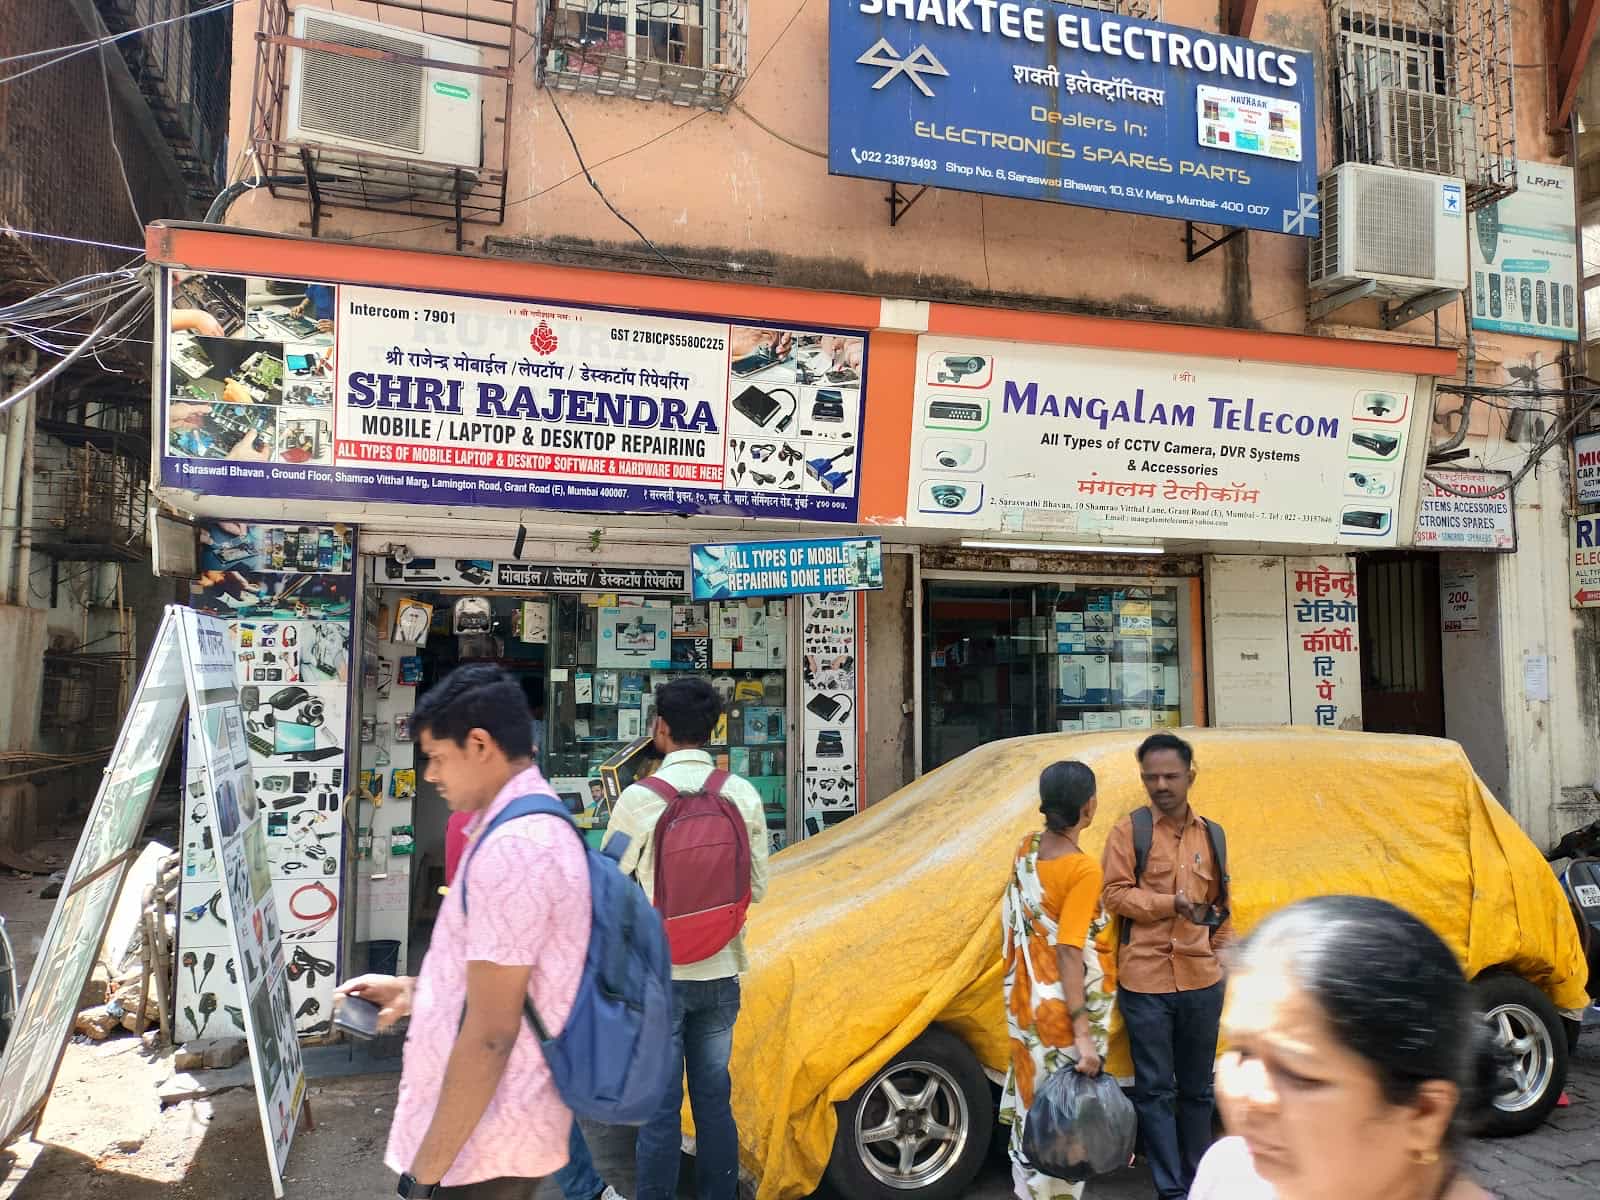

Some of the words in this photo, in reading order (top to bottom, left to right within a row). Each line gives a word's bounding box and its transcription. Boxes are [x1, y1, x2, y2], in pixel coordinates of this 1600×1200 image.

[1057, 13, 1297, 87] ELECTRONICS
[1012, 64, 1060, 87] शक्ती
[1065, 70, 1166, 106] इलेक्ट्रॉनिक्स
[1031, 105, 1117, 133] Dealers
[1124, 119, 1148, 137] In:
[914, 121, 1076, 159] ELECTRONICS
[1082, 146, 1173, 173] SPARES
[1179, 160, 1252, 185] PARTS
[861, 150, 882, 164] 022
[884, 153, 938, 171] 23879493
[945, 162, 974, 177] Shop
[975, 166, 994, 178] No.
[1007, 171, 1063, 188] Saraswati
[1064, 178, 1107, 195] Bhawan,
[1109, 184, 1124, 197] 10,
[1126, 187, 1144, 199] S.V.
[1146, 190, 1175, 205] Marg,
[1220, 201, 1244, 213] 400
[1247, 204, 1270, 216] 007
[349, 301, 410, 320] Intercom
[423, 309, 456, 325] 7901
[610, 328, 630, 342] GST
[632, 330, 725, 351] 27BICPS5580C2Z5
[385, 346, 404, 366] श्री
[408, 348, 450, 371] राजेन्द्र
[453, 351, 507, 377] मोबाईल
[579, 363, 636, 386] डेस्कटॉप
[639, 368, 690, 391] रिपेयरिंग
[347, 371, 464, 415] SHRI
[475, 381, 720, 435] RAJENDRA
[362, 415, 431, 439] MOBILE
[435, 419, 444, 442] /
[449, 420, 516, 444] LAPTOP
[522, 426, 534, 446] &
[541, 428, 616, 452] DESKTOP
[621, 433, 706, 458] REPAIRING
[1040, 432, 1059, 446] All
[1063, 434, 1102, 450] Types
[1106, 437, 1121, 450] of
[1124, 438, 1161, 452] CCTV
[1164, 441, 1216, 459] Camera,
[1220, 445, 1246, 458] DVR
[1249, 447, 1300, 463] Systems
[338, 442, 357, 458] ALL
[359, 443, 393, 460] TYPES
[395, 446, 410, 461] OF
[412, 447, 452, 464] MOBILE
[455, 450, 493, 466] LAPTOP
[495, 453, 504, 467] &
[507, 454, 551, 470] DESKTOP
[554, 457, 606, 473] SOFTWARE
[608, 460, 616, 474] &
[618, 461, 671, 478] HARDWARE
[672, 464, 697, 479] DONE
[699, 466, 723, 481] HERE
[1127, 459, 1137, 471] &
[1141, 460, 1218, 476] Accessories
[1577, 467, 1594, 479] CAR
[174, 464, 180, 473] 1
[182, 464, 228, 476] Saraswati
[229, 466, 265, 478] Bhavan
[271, 469, 306, 481] Ground
[308, 471, 333, 483] Floor,
[335, 472, 375, 485] Shamrao
[376, 475, 404, 487] Vitthal
[405, 477, 430, 490] Marg,
[431, 478, 476, 492] Lamington
[478, 481, 503, 493] Road,
[504, 482, 527, 494] Grant
[528, 483, 550, 495] Road
[551, 485, 566, 497] (E),
[567, 486, 599, 498] Mumbai
[599, 487, 630, 499] 400007.
[1077, 471, 1157, 498] मंगलम
[1162, 479, 1260, 504] टेलीकॉम
[998, 498, 1040, 508] Saraswathi
[1085, 502, 1119, 512] Shamrao
[1120, 504, 1145, 513] Vitthal
[1168, 507, 1190, 516] Grant
[1191, 508, 1210, 517] Road
[1225, 510, 1255, 519] Mumbai
[1284, 513, 1296, 521] 022
[1105, 513, 1125, 522] Email
[1421, 500, 1451, 512] STEMS
[1453, 502, 1508, 514] ACCESSORIES
[1462, 516, 1495, 529] SPARES
[729, 551, 749, 569] ALL
[751, 549, 787, 568] TYPES
[789, 547, 804, 566] OF
[807, 545, 849, 565] MOBILE
[500, 564, 541, 586] मोबाईल
[552, 566, 588, 587] लेपटॉप
[599, 568, 641, 590] डेस्कटॉप
[728, 570, 787, 592] REPAIRING
[791, 569, 820, 588] DONE
[824, 567, 852, 585] HERE
[1294, 564, 1357, 598] महेन्द्र
[1293, 598, 1357, 624] रेडियो
